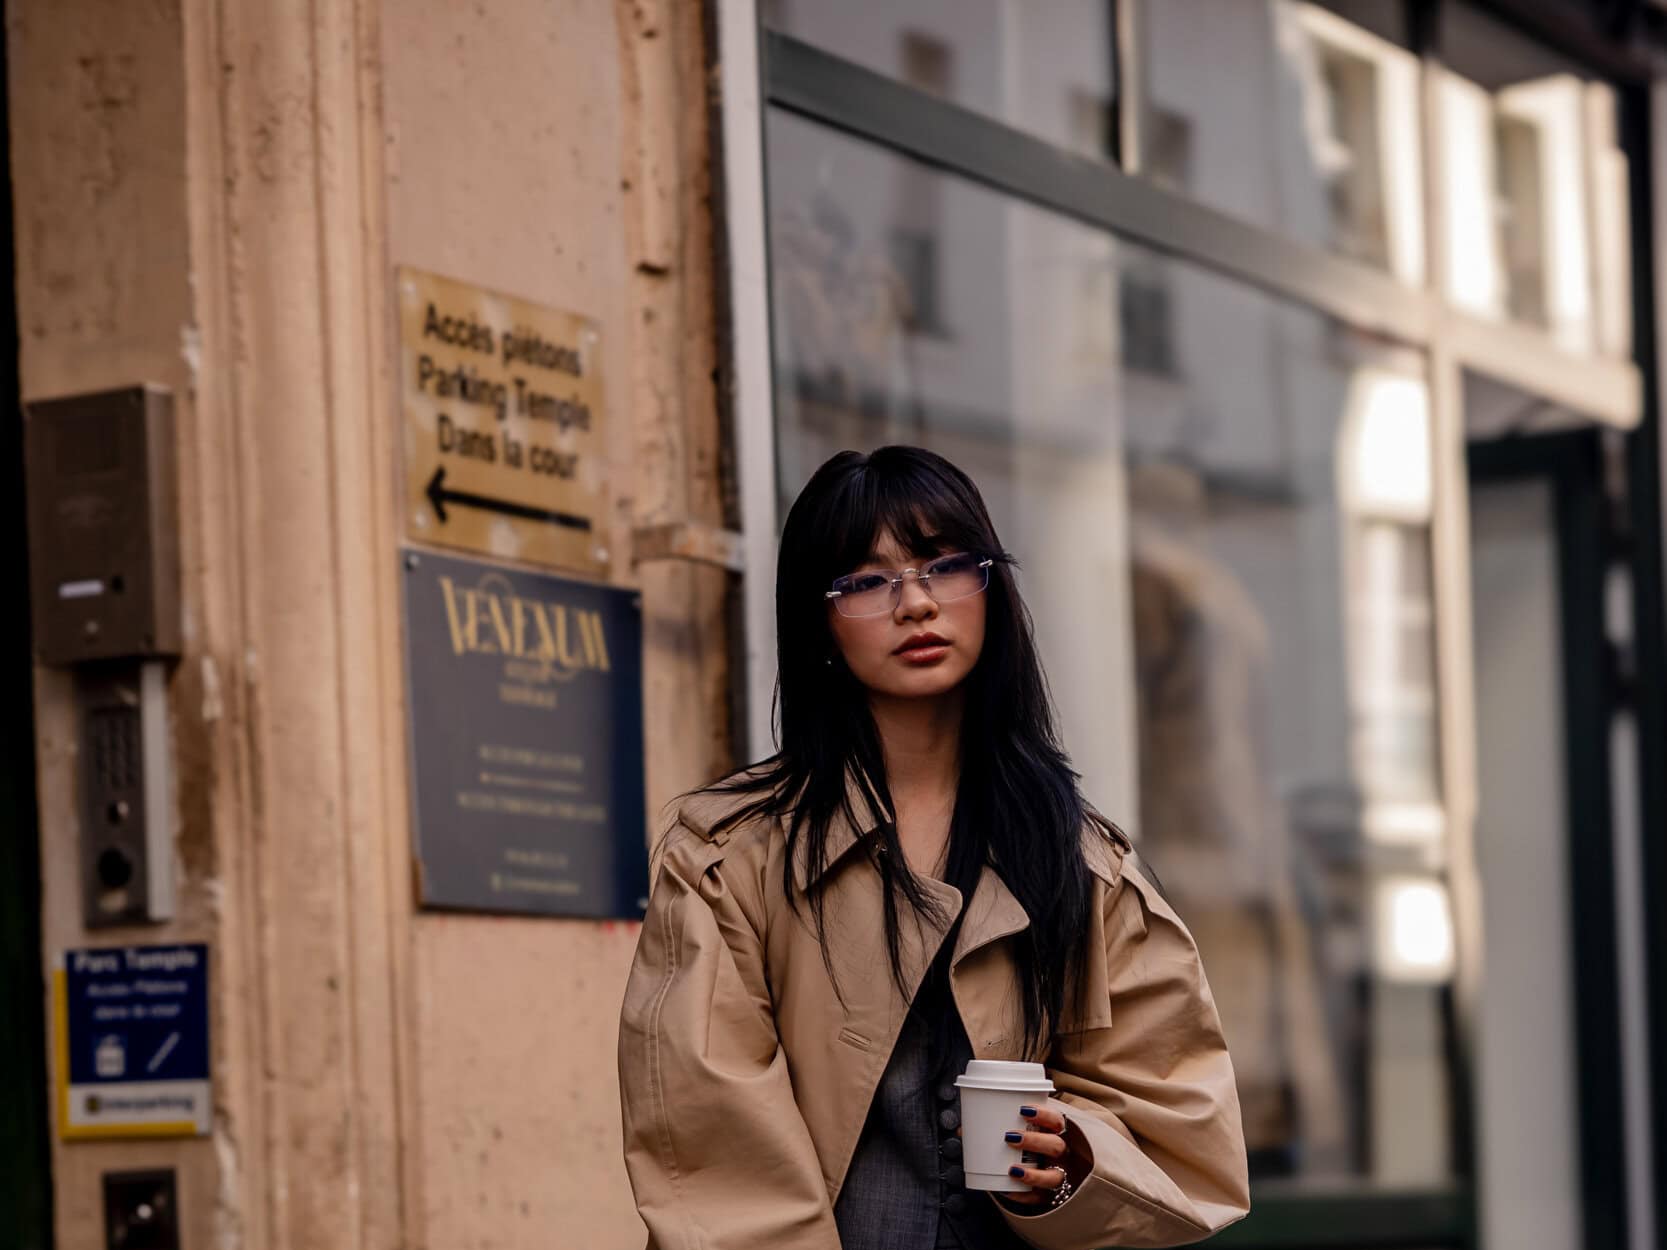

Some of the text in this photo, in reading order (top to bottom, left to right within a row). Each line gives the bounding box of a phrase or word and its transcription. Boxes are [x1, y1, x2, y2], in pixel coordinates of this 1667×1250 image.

[418, 354, 506, 421] Parking
[438, 413, 496, 462] Dans
[503, 430, 523, 468] la
